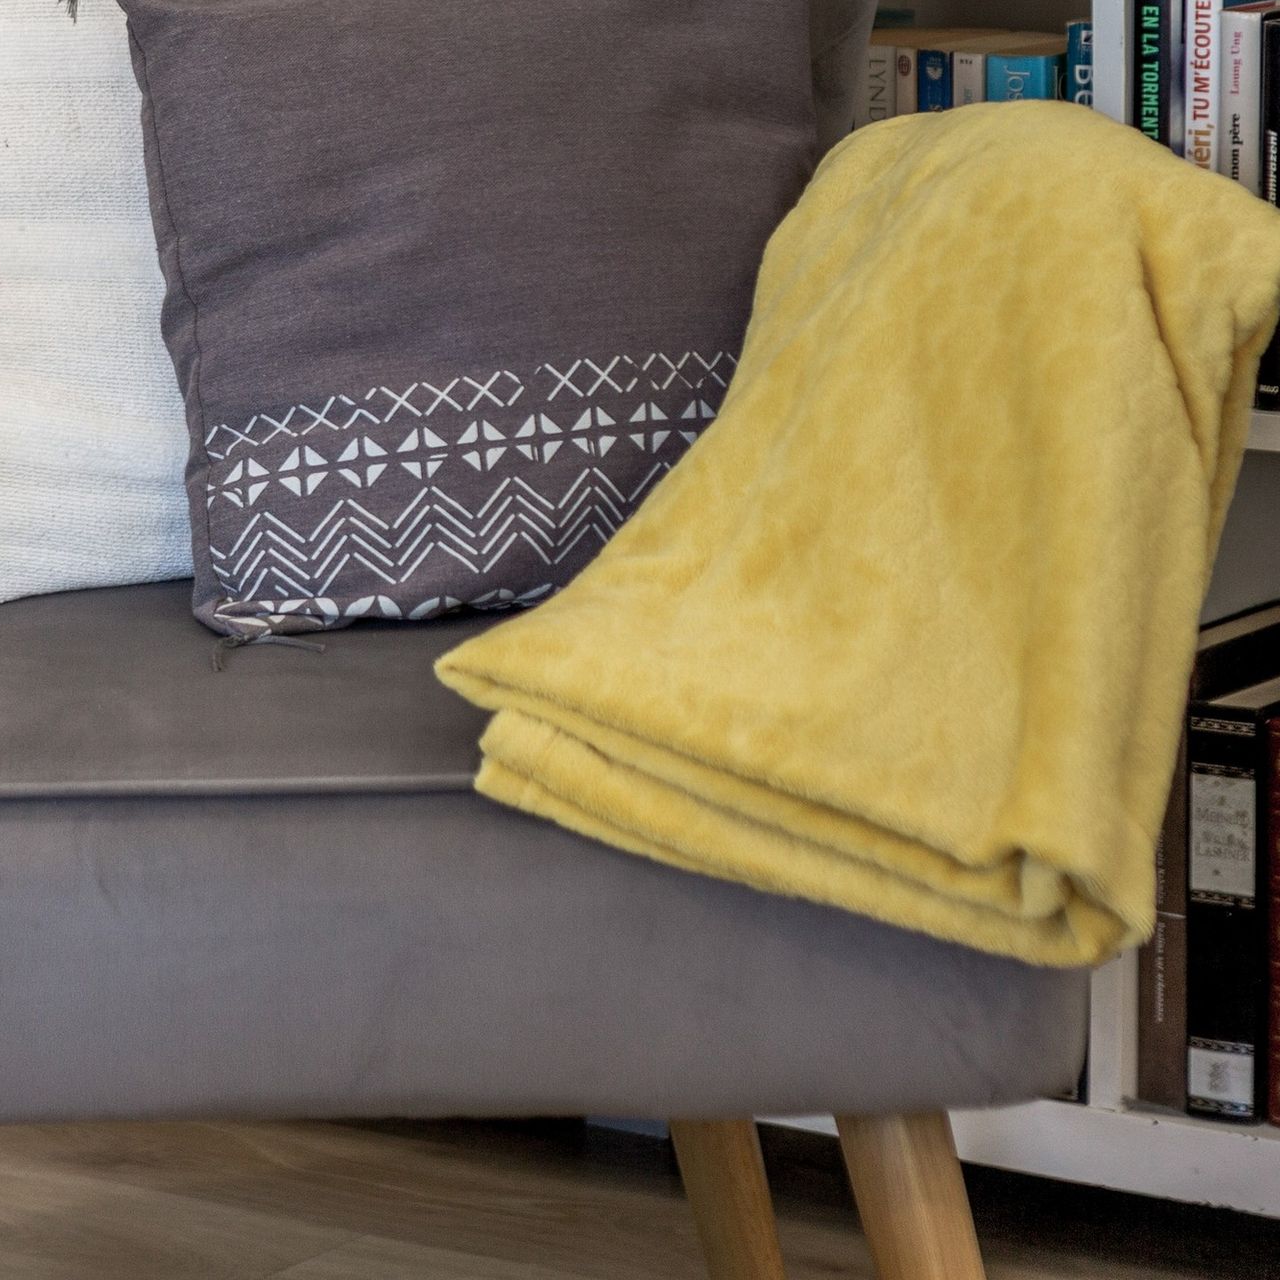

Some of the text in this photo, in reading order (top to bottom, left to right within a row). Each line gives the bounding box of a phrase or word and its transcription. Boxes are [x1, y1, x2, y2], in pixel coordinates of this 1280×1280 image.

[1141, 6, 1160, 28] EN
[1141, 33, 1160, 54] LA
[1228, 31, 1245, 96] Loung Ung
[1192, 98, 1210, 122] TU
[1227, 113, 1246, 181] mon père
